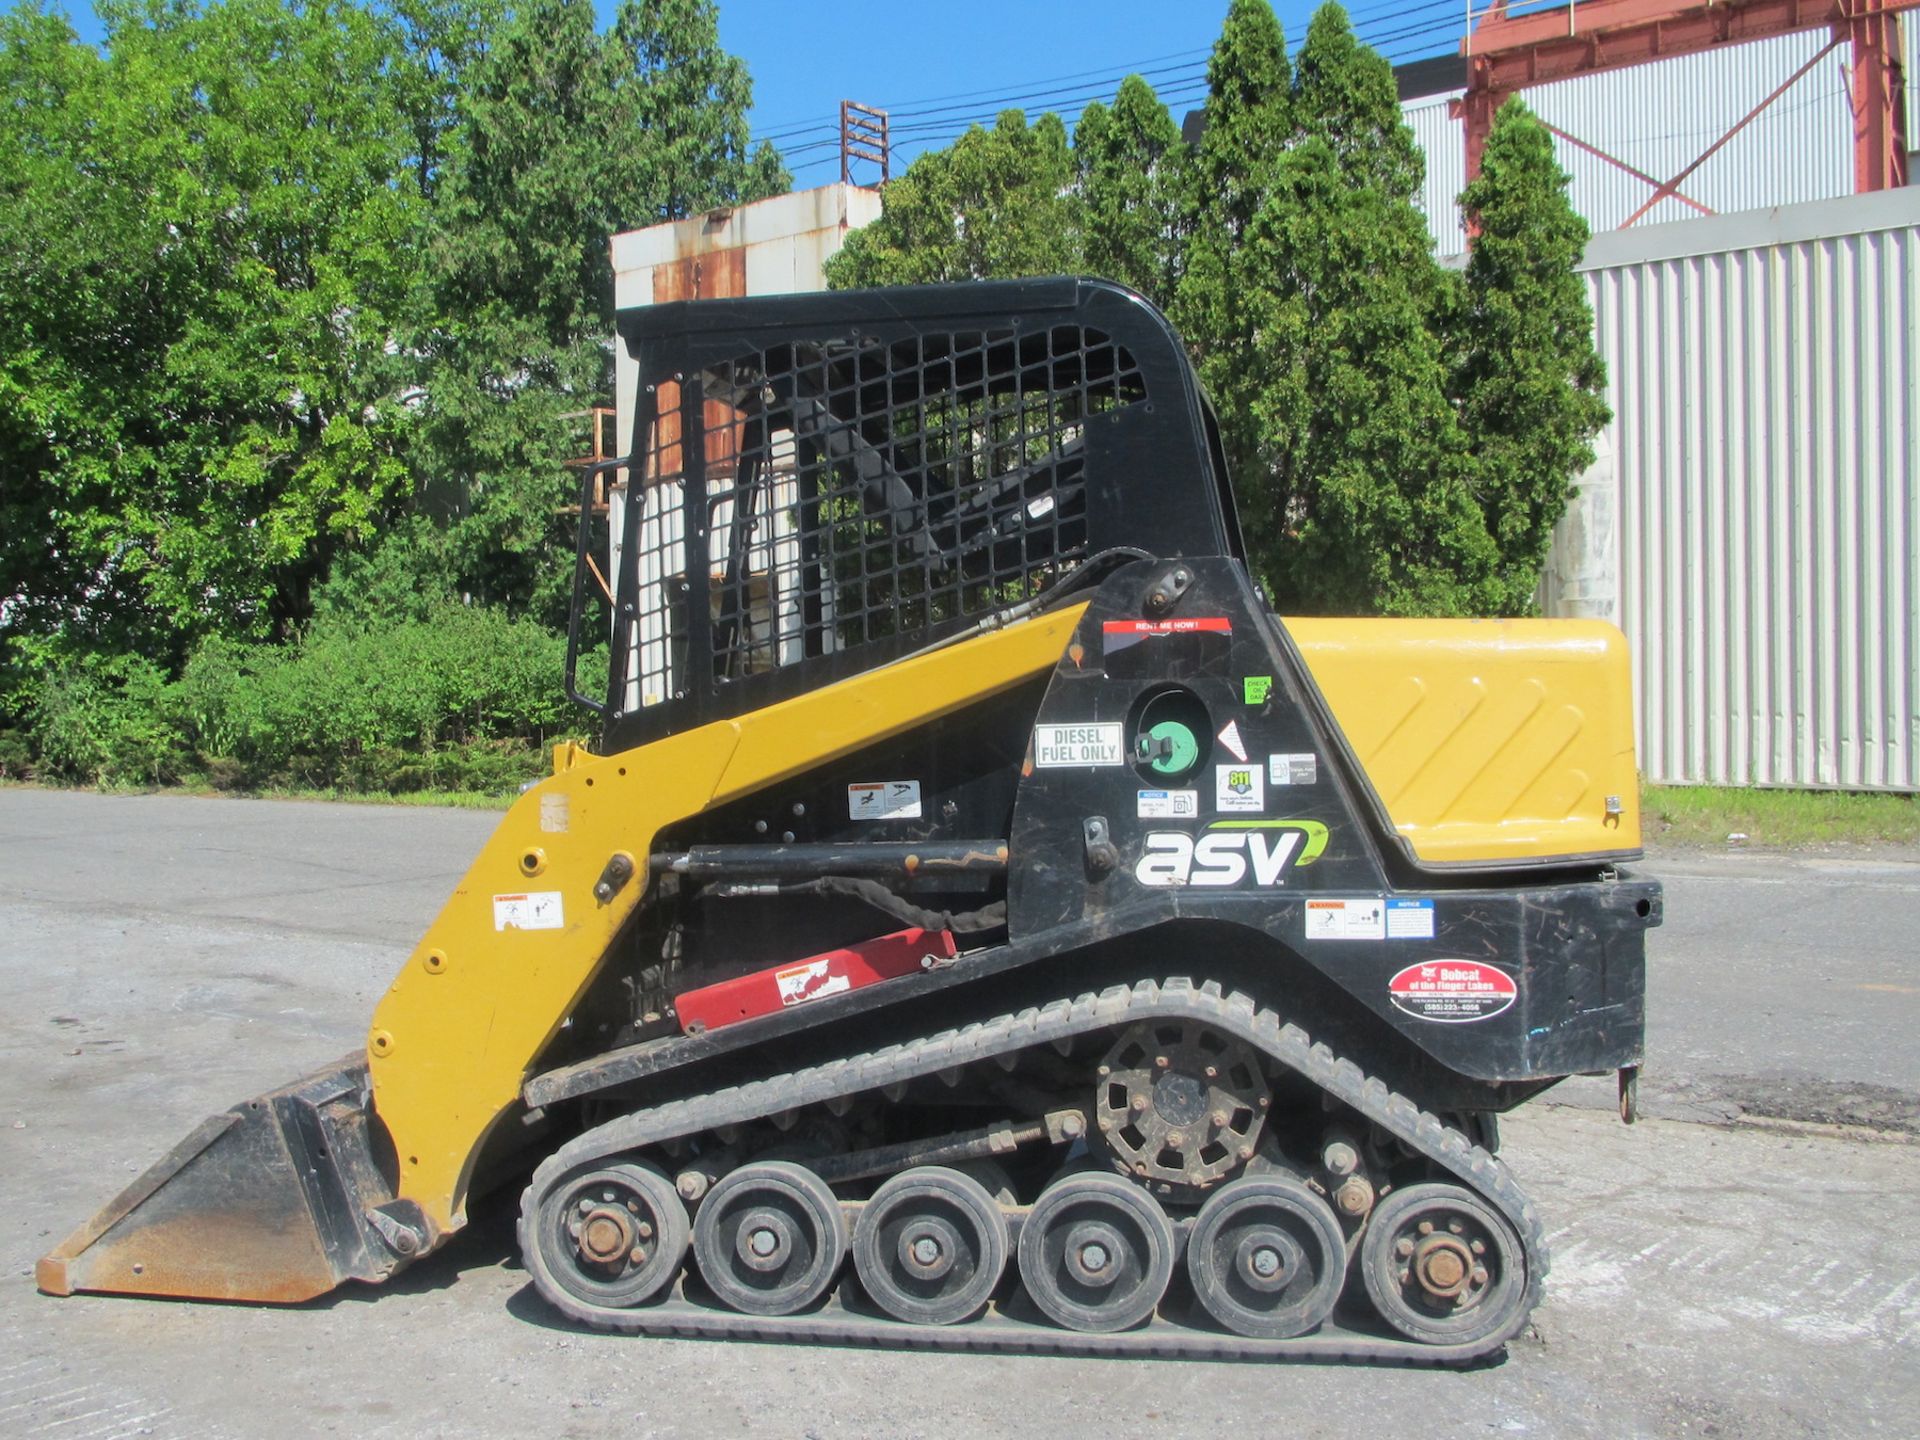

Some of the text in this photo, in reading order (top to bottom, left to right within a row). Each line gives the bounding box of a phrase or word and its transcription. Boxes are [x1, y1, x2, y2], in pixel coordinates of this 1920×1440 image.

[1135, 622, 1157, 630] RENT
[1054, 728, 1104, 745] DIESEL
[1042, 745, 1116, 762] FUEL ONLY
[1230, 771, 1250, 786] 811
[1440, 968, 1480, 981] Bobcat
[1409, 981, 1495, 991] of the Finger Lakes
